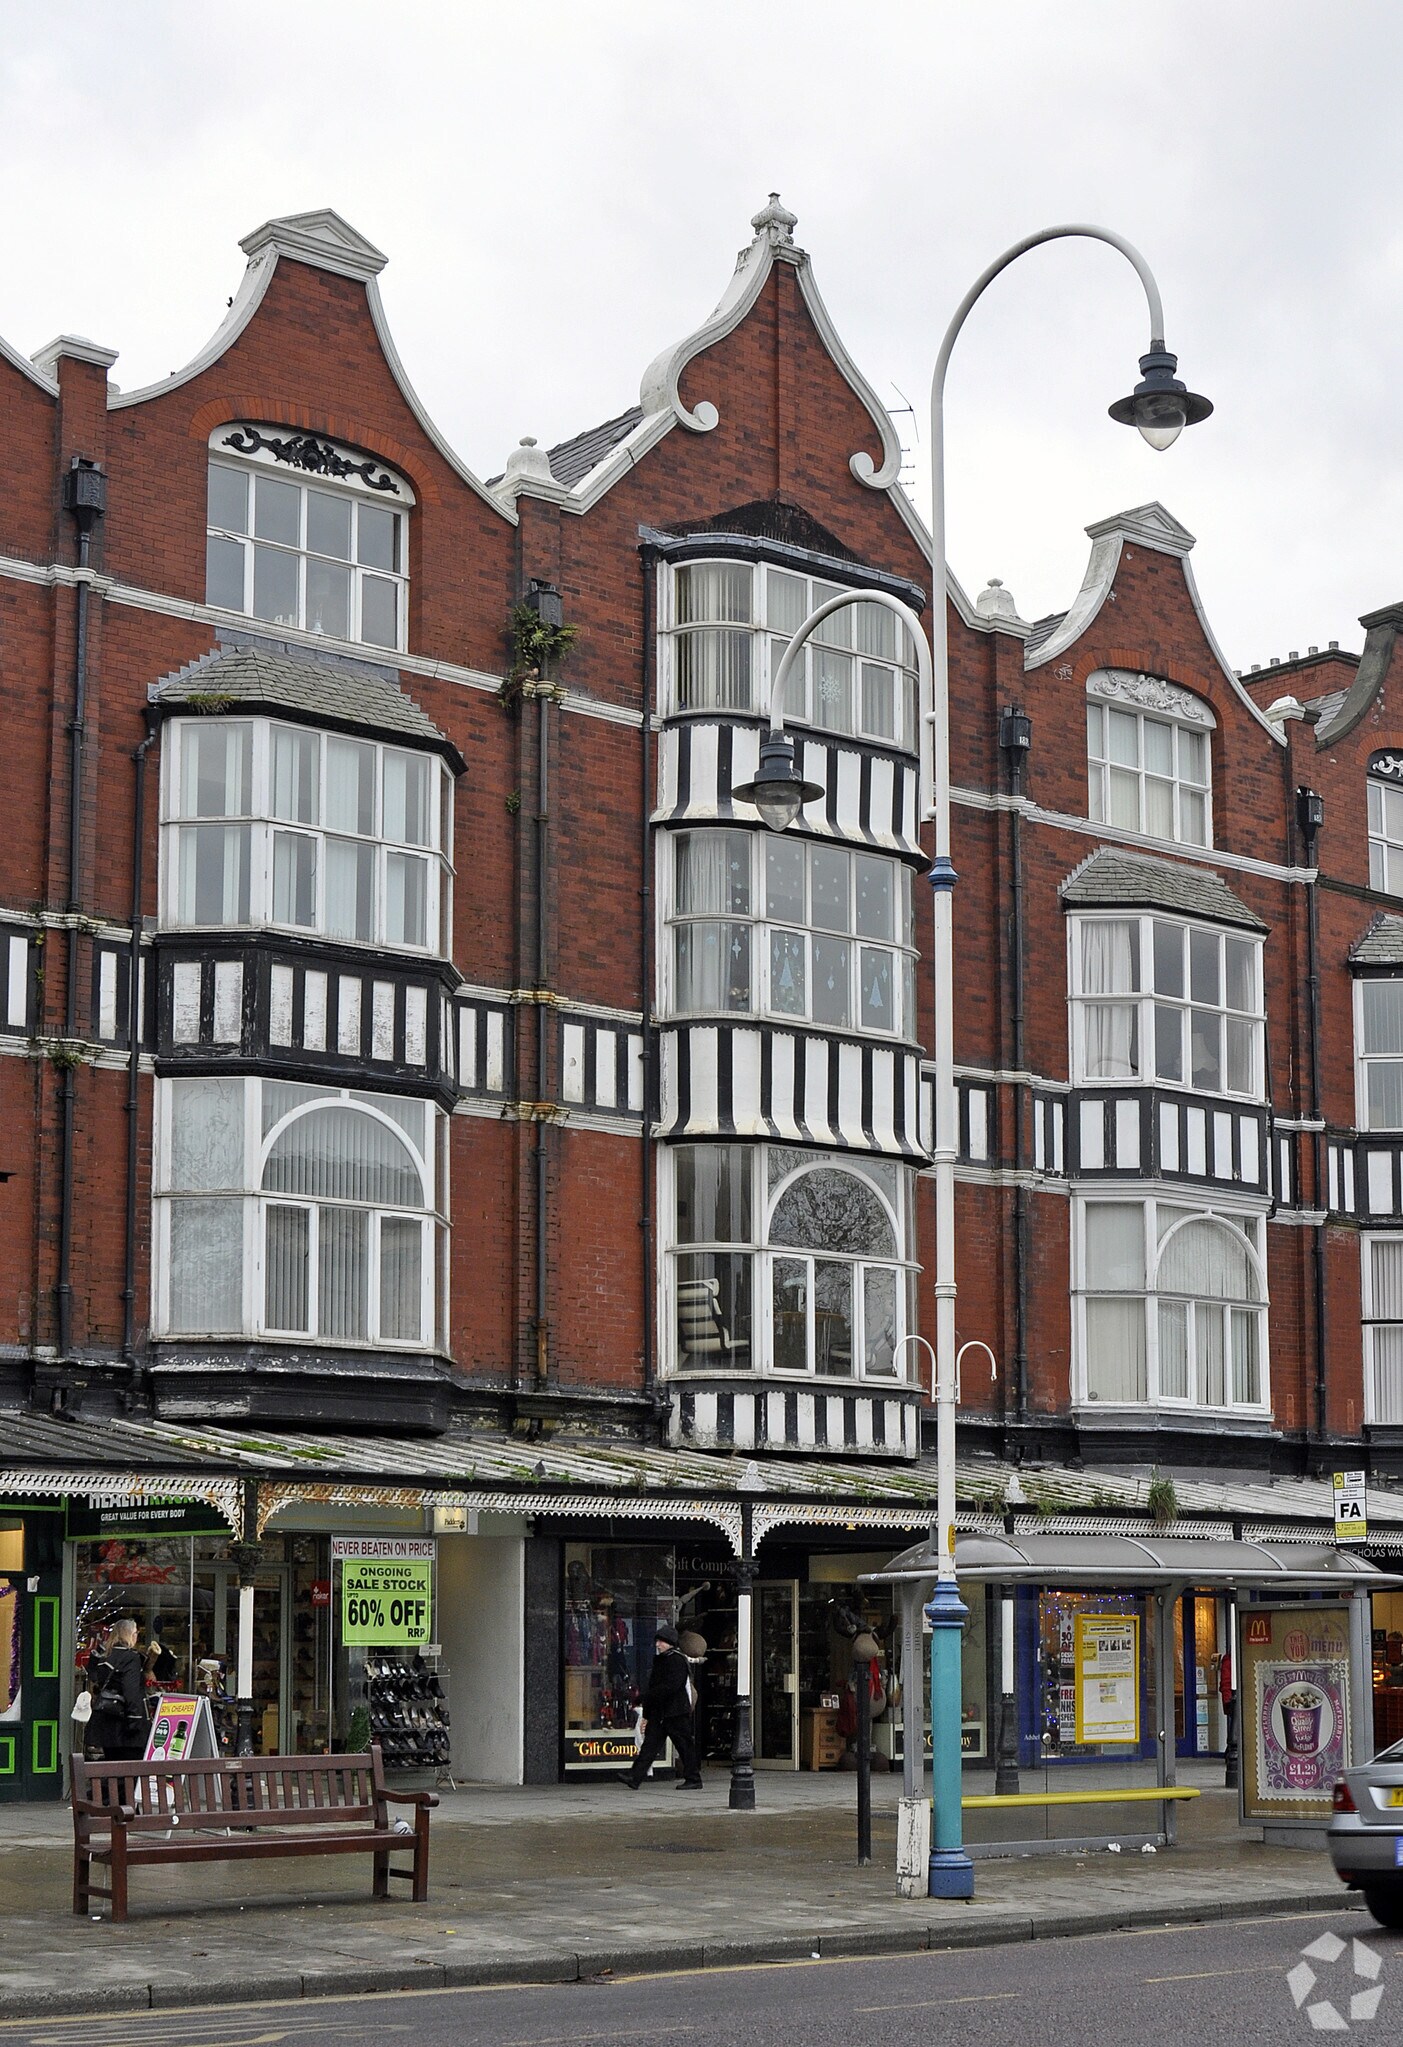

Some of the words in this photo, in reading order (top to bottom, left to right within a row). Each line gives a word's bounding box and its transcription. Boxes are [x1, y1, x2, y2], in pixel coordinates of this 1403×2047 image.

[100, 1513, 119, 1521] GREAT
[120, 1512, 138, 1520] VALUE
[138, 1511, 150, 1520] FOR
[150, 1510, 169, 1519] EVERY
[169, 1509, 186, 1518] BODY
[1340, 1503, 1361, 1518] FA
[332, 1541, 359, 1555] NEVER
[361, 1541, 393, 1555] BEATEN
[394, 1542, 406, 1555] ON
[408, 1542, 433, 1556] PRICE
[1349, 1548, 1386, 1558] CHOLAS
[360, 1567, 412, 1577] ONGOING
[346, 1579, 379, 1589] SALE
[382, 1580, 426, 1590] STOCK
[347, 1599, 385, 1627] 60%
[390, 1600, 426, 1626] OFF
[407, 1628, 426, 1638] RRP
[171, 1704, 195, 1713] CHEAPER
[1061, 1700, 1075, 1712] NHS
[579, 1742, 601, 1756] Gift
[602, 1741, 639, 1757] Comp
[1289, 1763, 1317, 1775] £1.29
